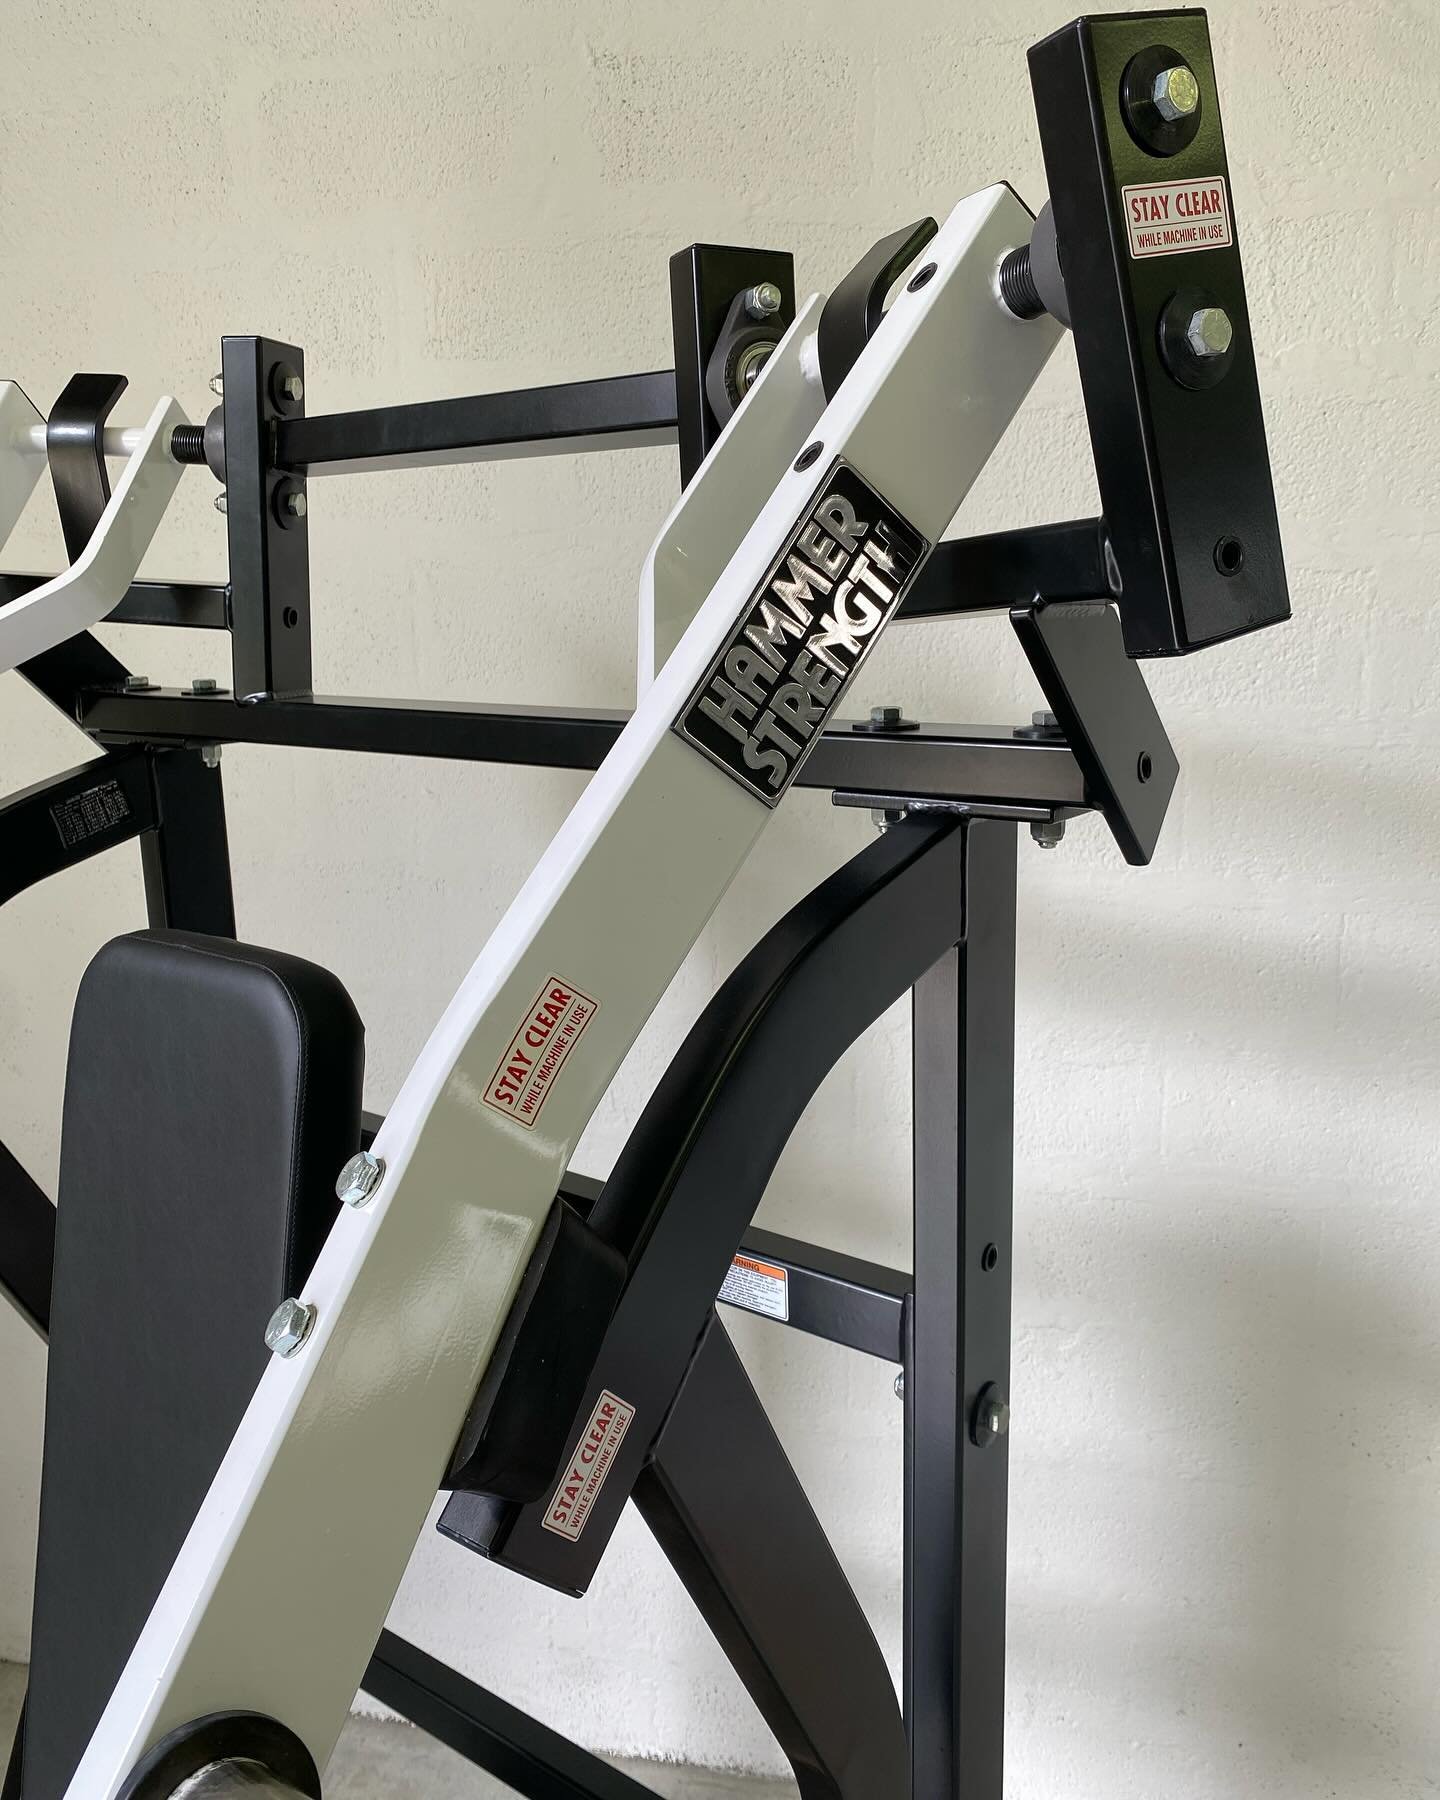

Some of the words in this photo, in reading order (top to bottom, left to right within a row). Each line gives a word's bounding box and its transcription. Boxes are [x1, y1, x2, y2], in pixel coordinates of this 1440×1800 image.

[1131, 195, 1169, 223] STAY
[1175, 190, 1222, 217] CLEAR
[1137, 232, 1162, 248] WHILE
[1163, 228, 1198, 245] MACHINE
[1199, 226, 1207, 240] IN
[1208, 224, 1223, 239] USE
[698, 494, 869, 744] HAMMER
[743, 519, 916, 789] STRENGTH
[494, 1048, 533, 1105] STAY
[525, 987, 572, 1048] CLEAR
[520, 1080, 544, 1114] WHILE
[537, 1035, 569, 1082] MACHINE
[562, 1024, 576, 1038] IN
[573, 1003, 588, 1025] USE
[552, 1467, 584, 1524] STAY
[580, 1402, 617, 1464] CLEAR
[570, 1494, 591, 1528] WHILE
[586, 1449, 611, 1494] MACHINE
[607, 1436, 618, 1448] IN
[614, 1414, 627, 1434] USE
